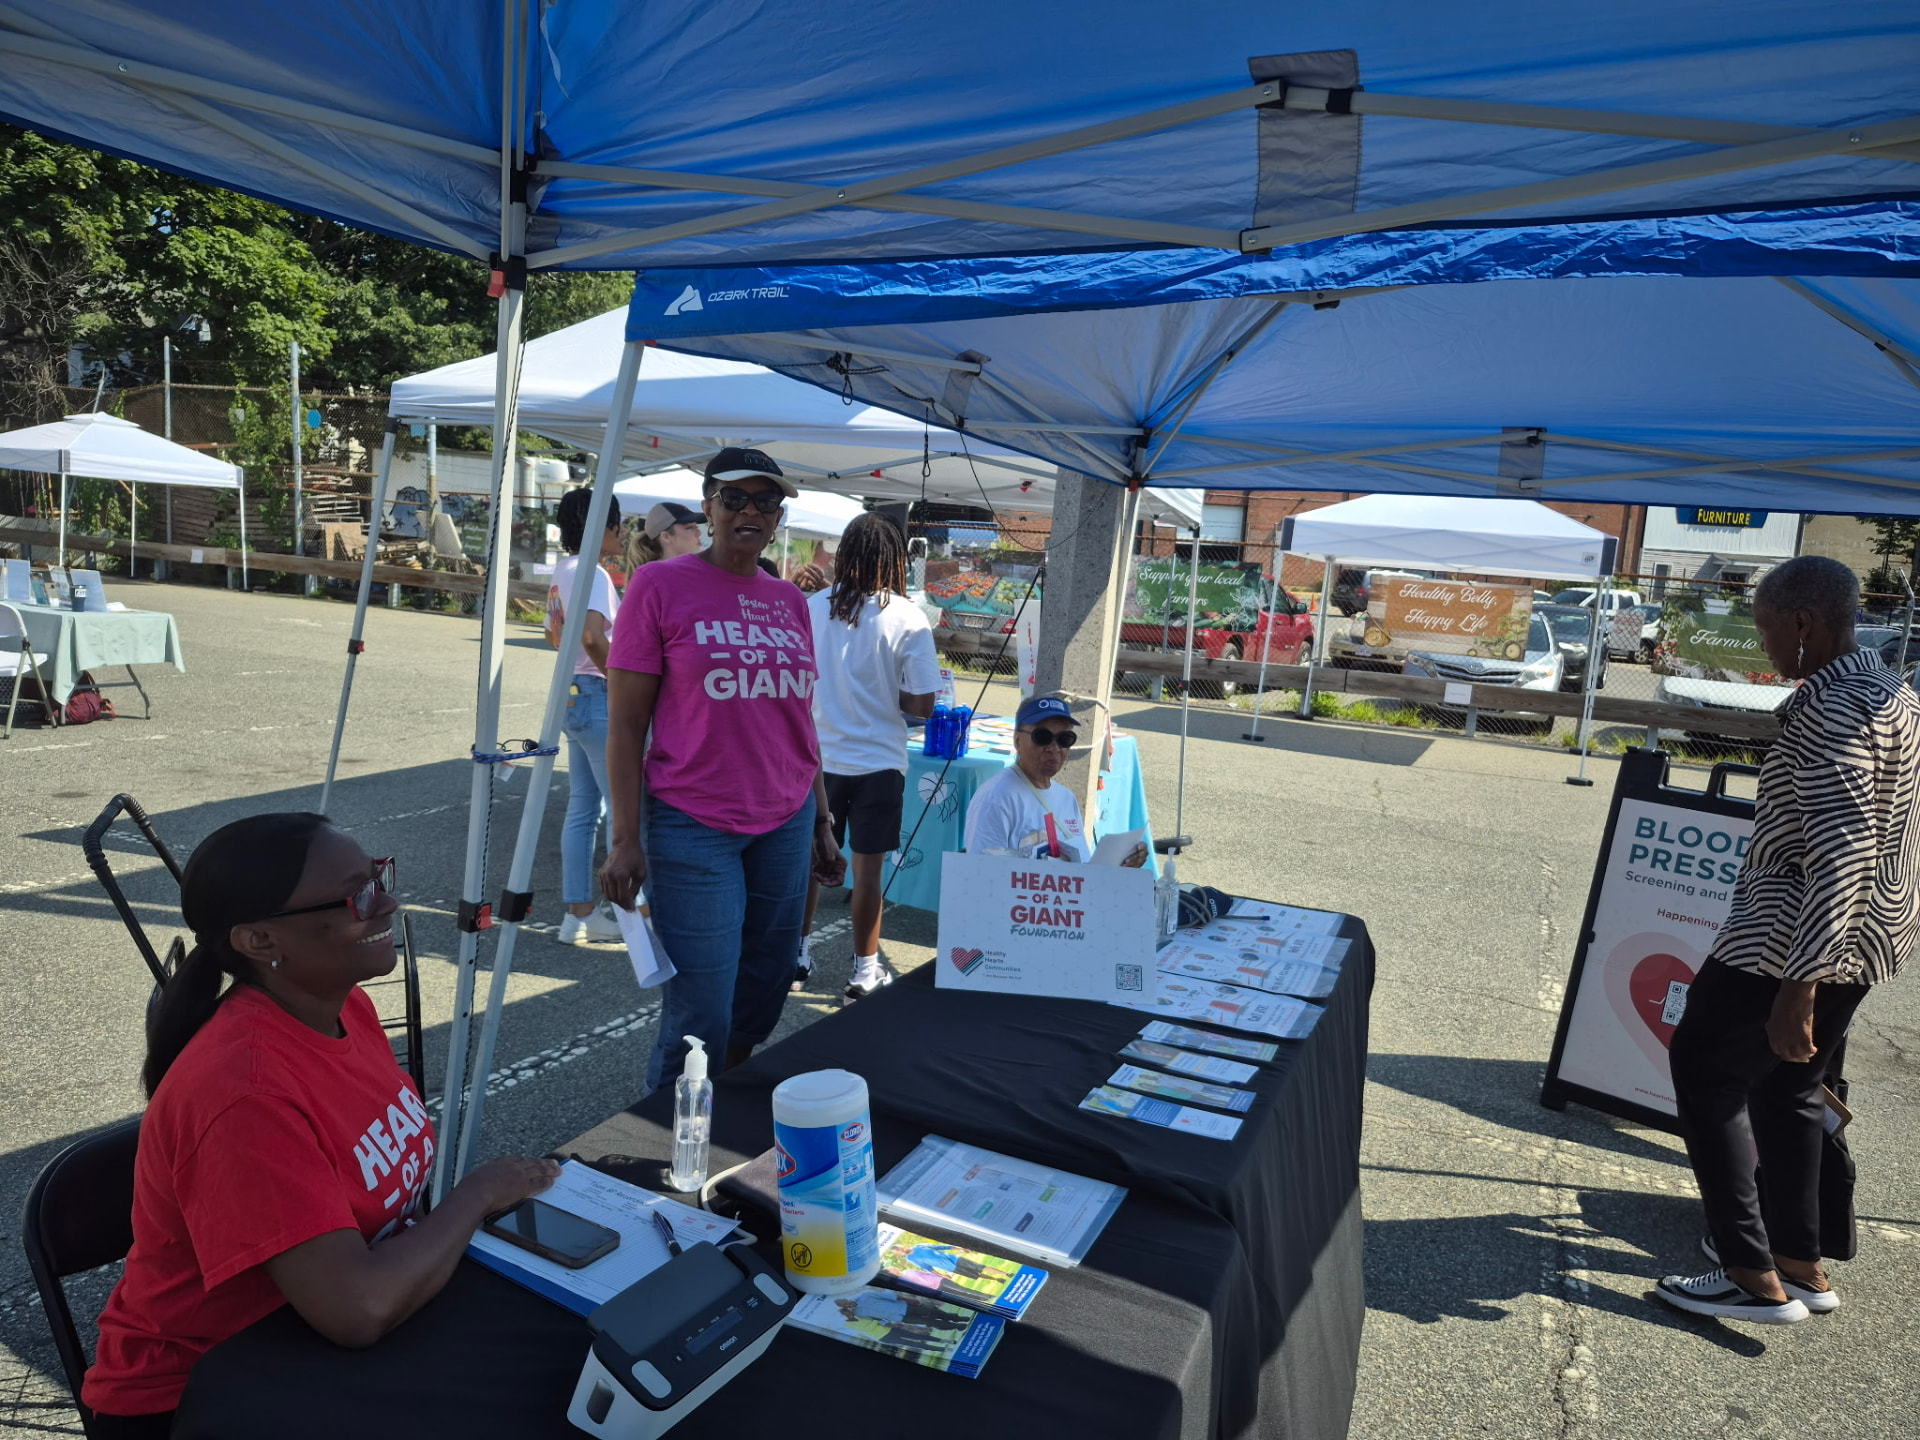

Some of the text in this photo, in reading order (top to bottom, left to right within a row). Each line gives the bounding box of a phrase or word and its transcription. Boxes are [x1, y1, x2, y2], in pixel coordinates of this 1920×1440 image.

[1697, 508, 1751, 525] FURNITURE
[1139, 566, 1246, 587] Supprt yur local
[737, 593, 770, 610] Boston
[1399, 583, 1456, 606] Healthy
[1404, 608, 1489, 633] Happy Life
[695, 621, 807, 650] HEART
[1689, 629, 1758, 650] Farm to
[739, 648, 792, 664] OF A
[1010, 871, 1085, 894] HEART
[1624, 870, 1728, 902] Screening and
[1032, 894, 1063, 906] OF A
[1010, 905, 1085, 928] GIANT
[1656, 908, 1720, 931] Happening
[1010, 924, 1085, 941] FOUNDATION
[402, 1136, 434, 1190] OF A
